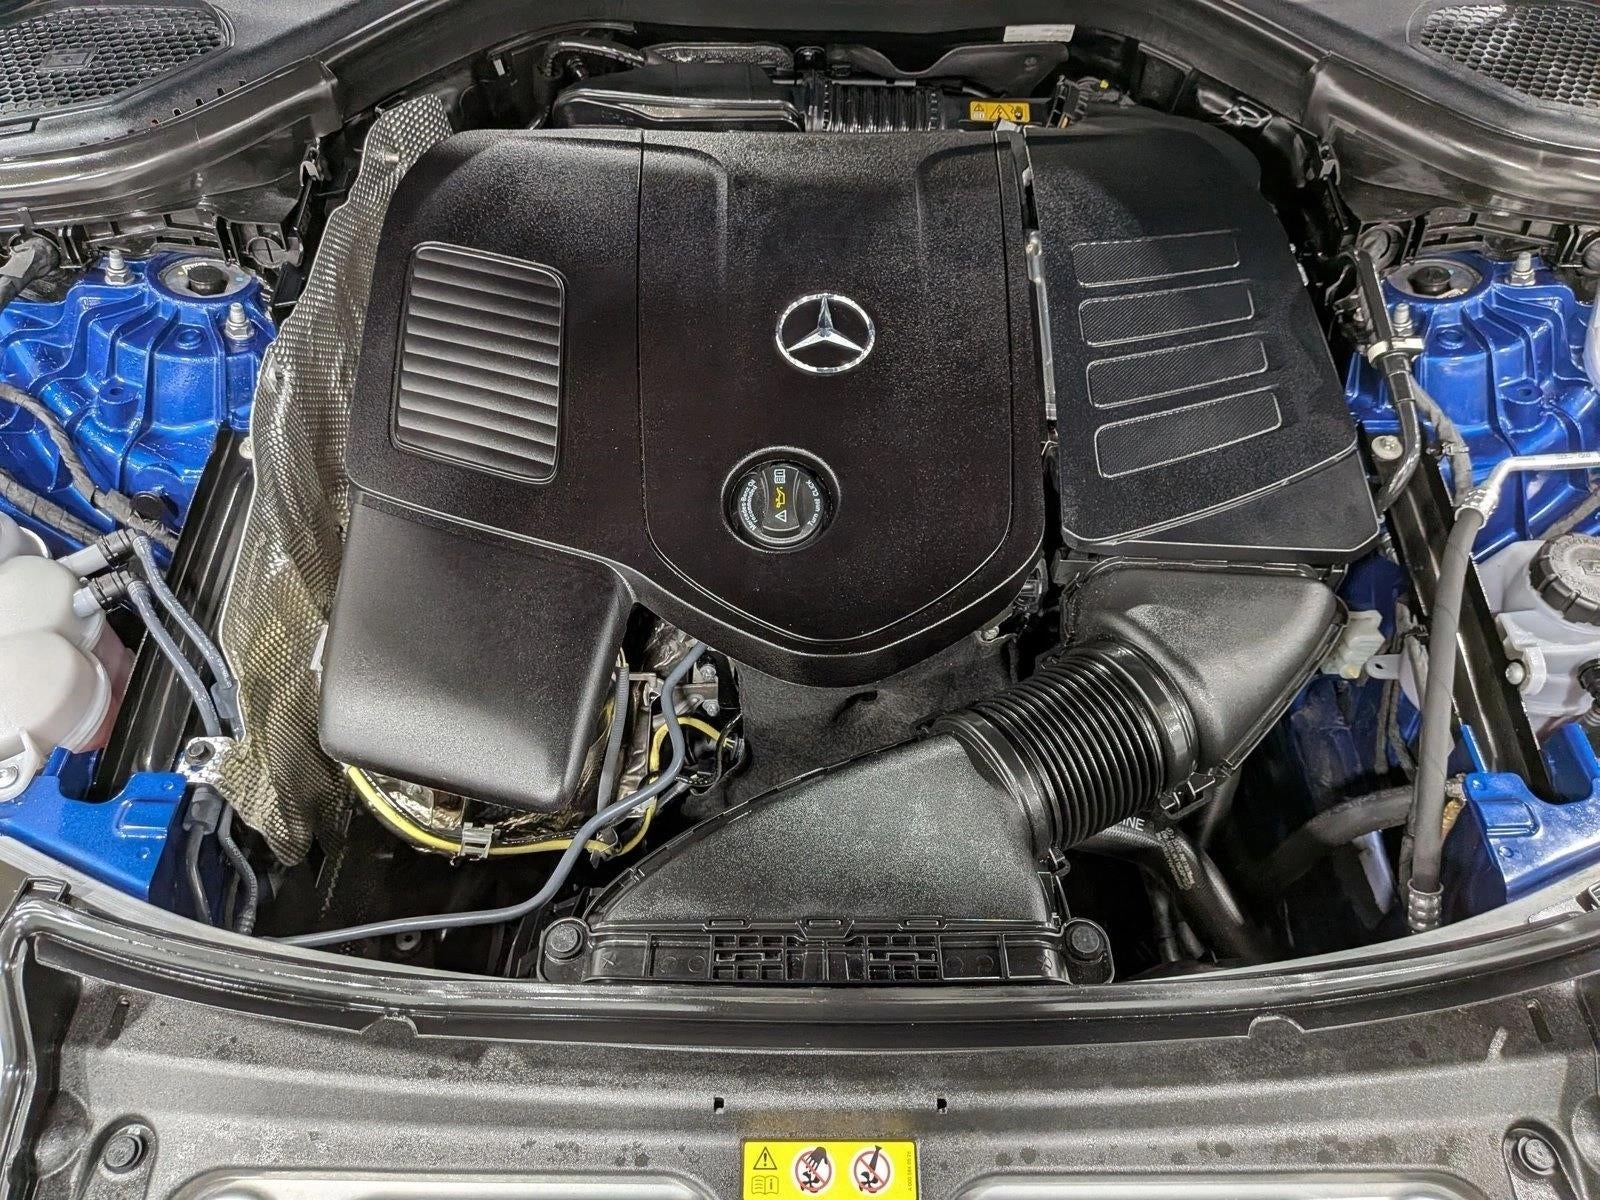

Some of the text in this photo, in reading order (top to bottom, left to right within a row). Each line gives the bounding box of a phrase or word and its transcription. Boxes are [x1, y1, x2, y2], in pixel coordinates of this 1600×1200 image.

[805, 480, 819, 497] CLICK
[741, 487, 757, 531] Mercedes-Benz
[807, 514, 819, 526] Turn
[1118, 816, 1145, 832] INE
